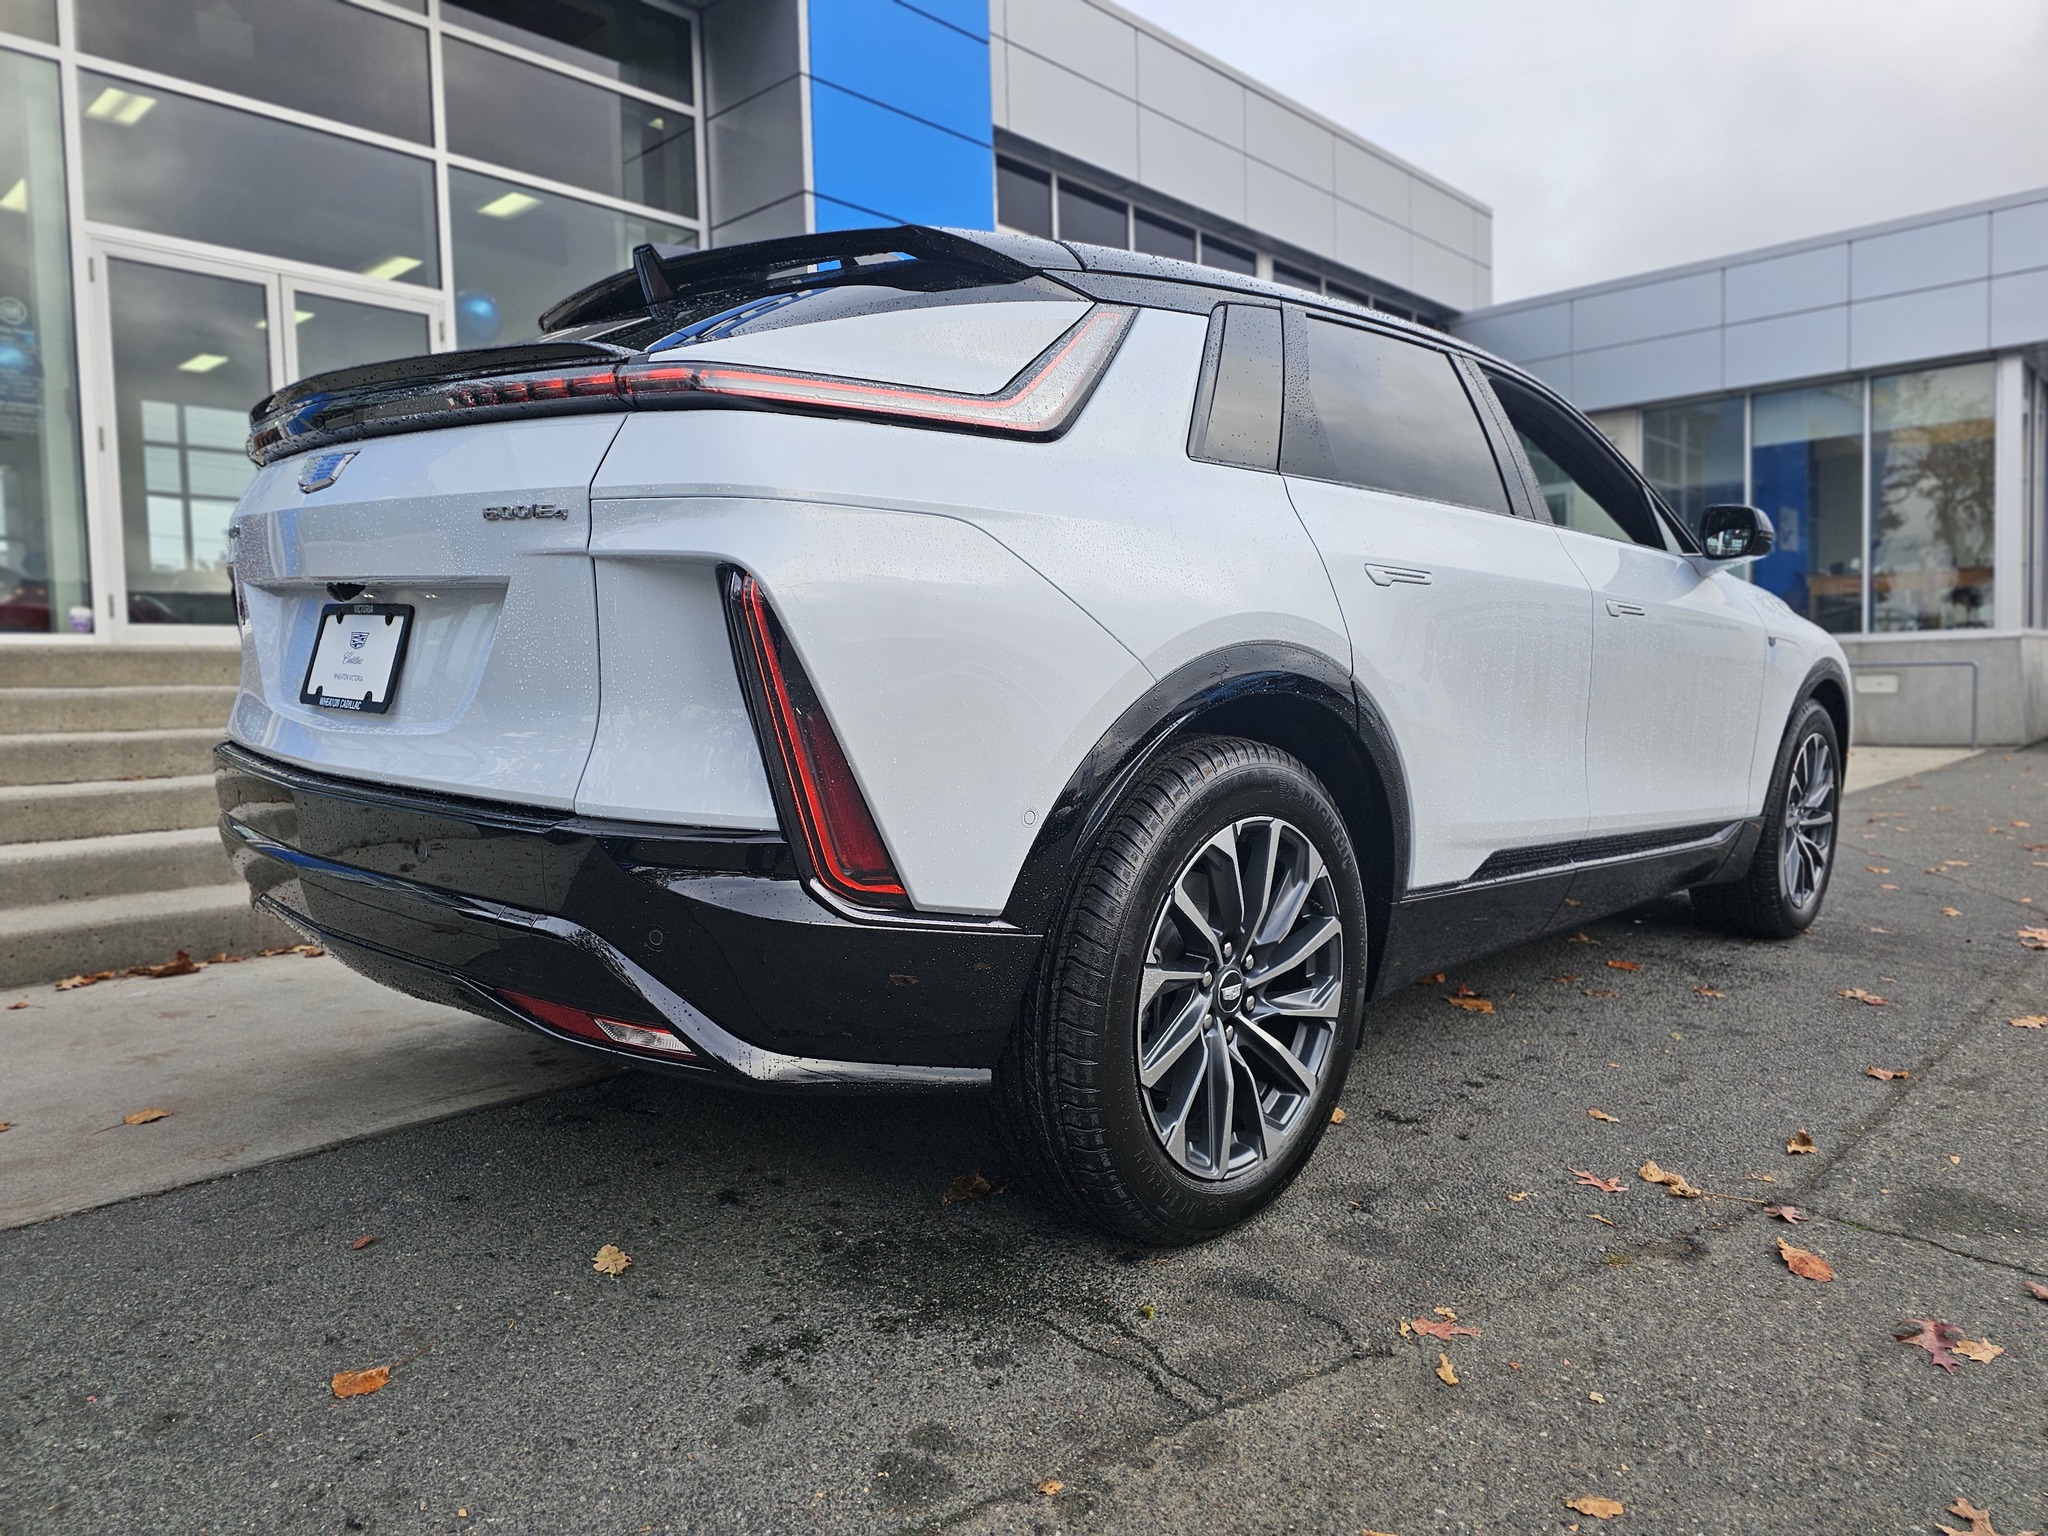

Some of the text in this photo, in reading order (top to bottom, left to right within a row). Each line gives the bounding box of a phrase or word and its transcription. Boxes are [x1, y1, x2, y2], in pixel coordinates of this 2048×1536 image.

[354, 605, 374, 613] VICTORIA
[343, 652, 363, 665] Cadillac
[319, 697, 361, 709] WHEATON CADILLAC
[1301, 792, 1355, 871] MICHELIN
